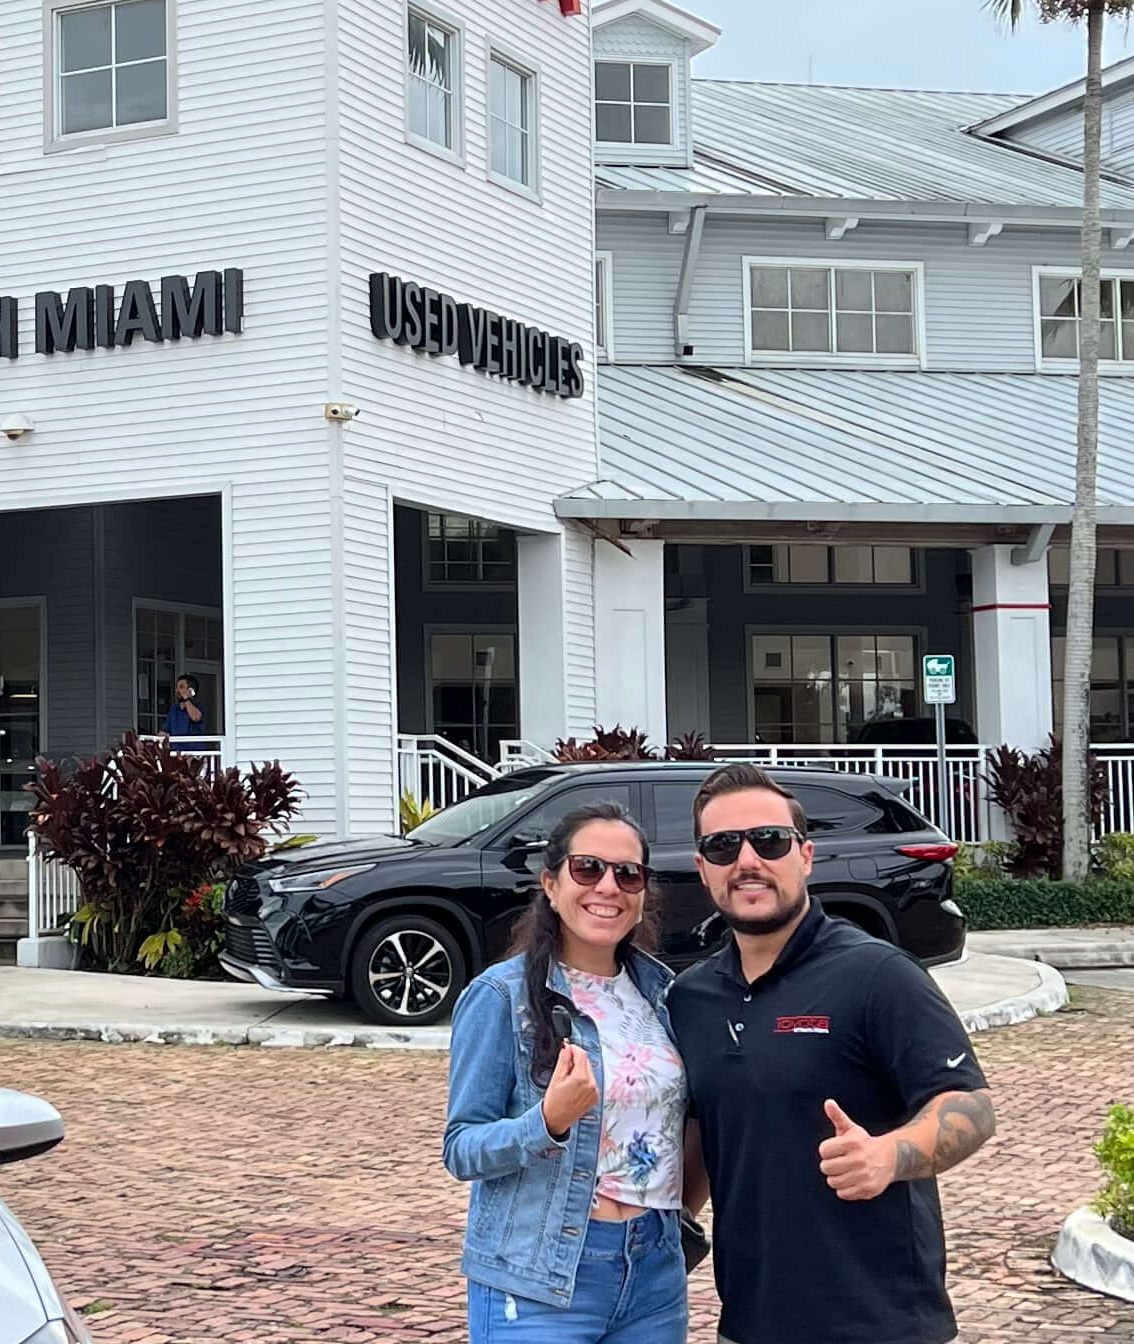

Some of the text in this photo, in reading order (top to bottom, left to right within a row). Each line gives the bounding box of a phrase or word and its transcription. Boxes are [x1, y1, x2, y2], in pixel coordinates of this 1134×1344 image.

[35, 267, 244, 354] MIAMI
[369, 272, 584, 399] USED VEHICLES
